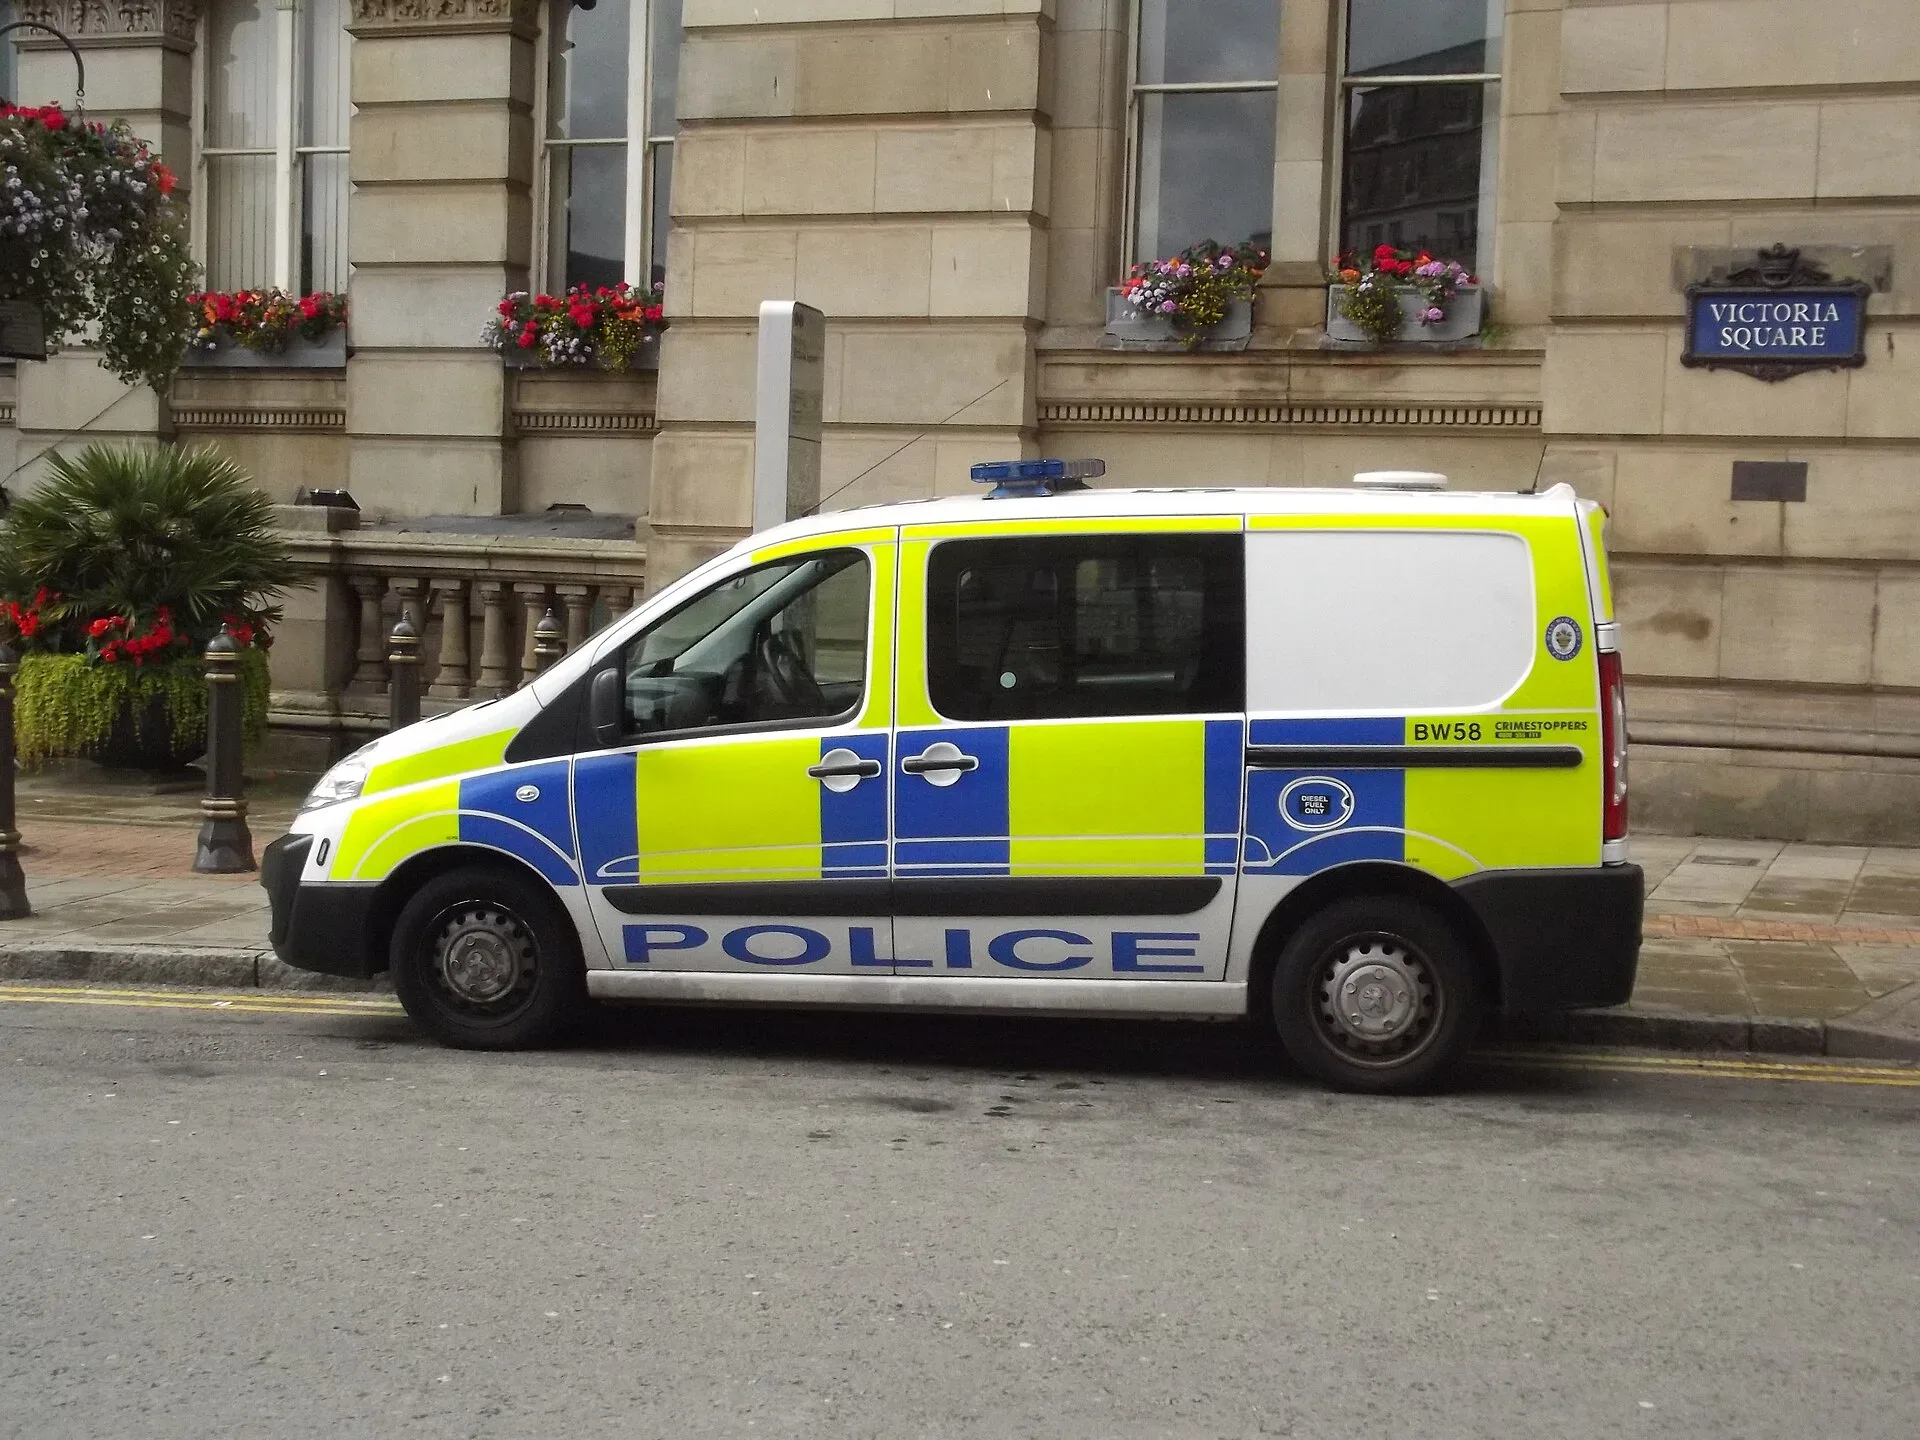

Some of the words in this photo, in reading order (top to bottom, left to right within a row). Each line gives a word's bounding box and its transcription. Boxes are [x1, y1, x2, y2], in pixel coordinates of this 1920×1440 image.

[1710, 303, 1841, 323] VICTORIA
[1720, 327, 1826, 350] SQUARE
[1414, 722, 1482, 741] BW58
[1495, 721, 1588, 731] CRIMESTOPPERS
[622, 924, 1205, 974] POLICE
